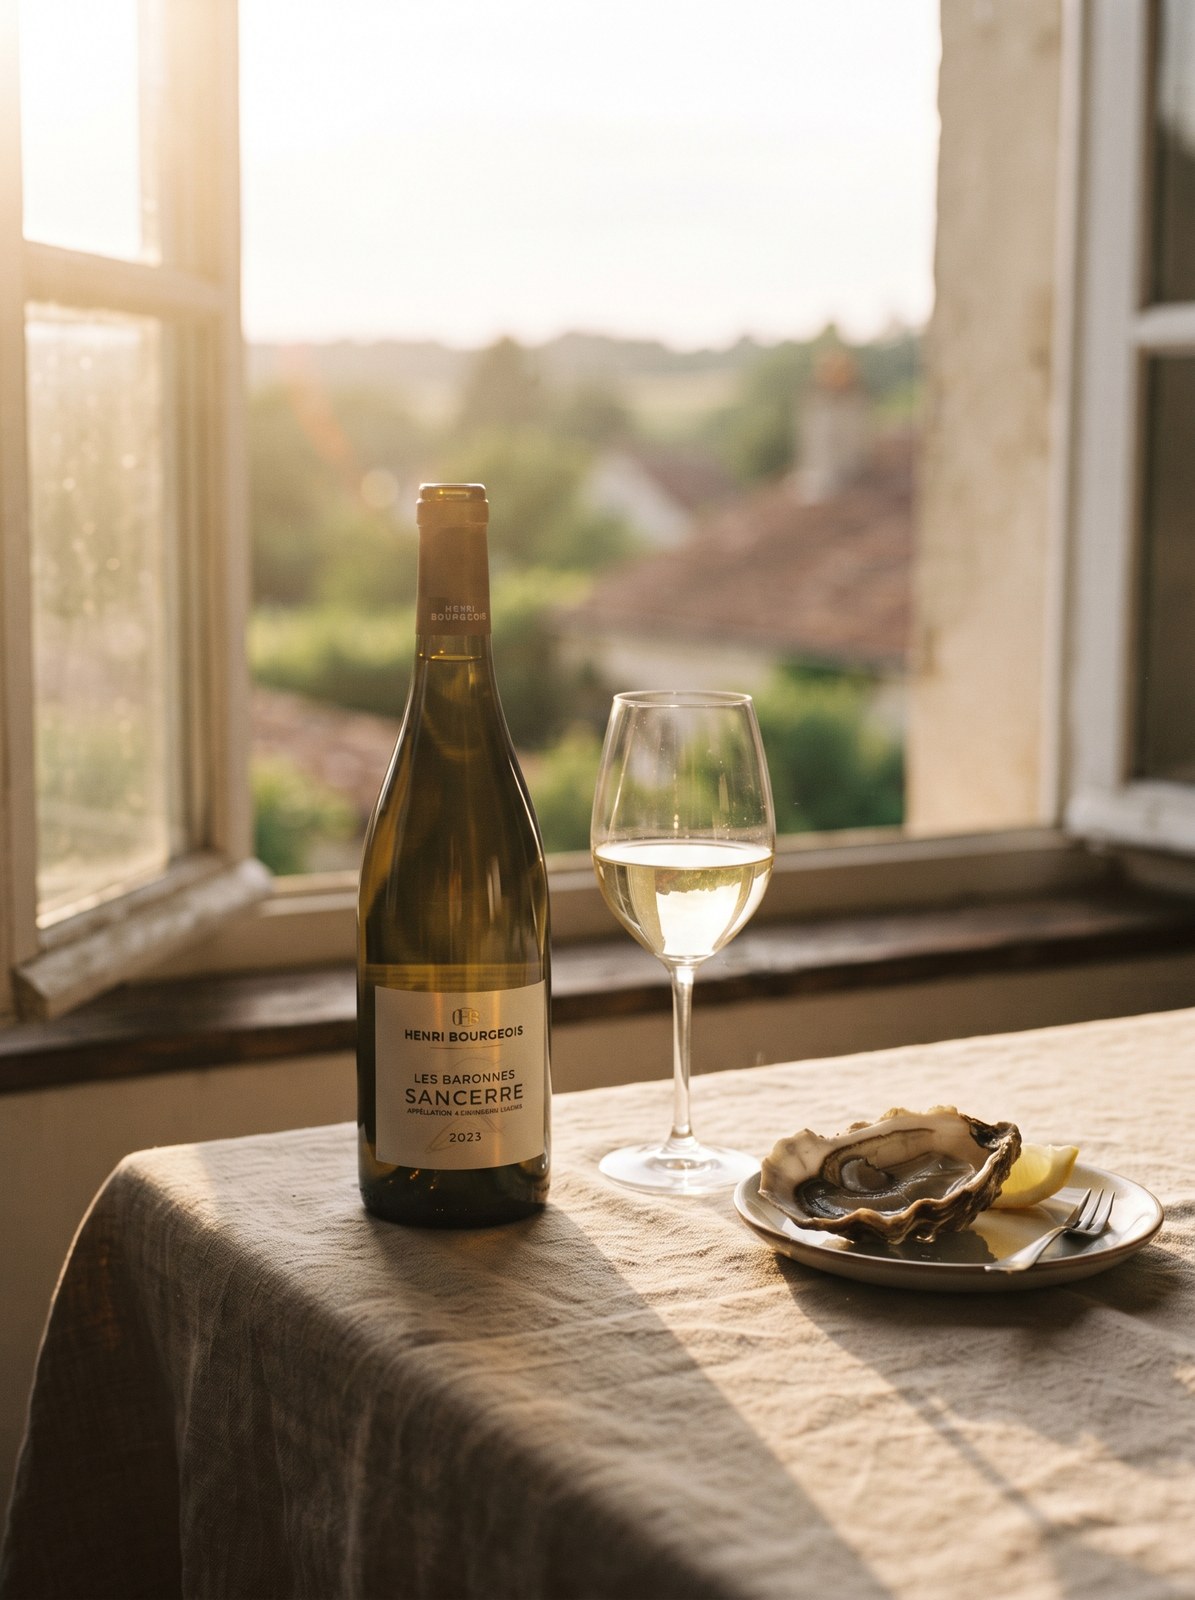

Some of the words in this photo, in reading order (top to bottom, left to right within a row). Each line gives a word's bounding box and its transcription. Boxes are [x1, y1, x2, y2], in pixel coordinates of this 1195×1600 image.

[405, 1029, 444, 1042] HENRI
[449, 1025, 523, 1042] BOURGEOIS
[414, 1073, 438, 1085] LES
[443, 1069, 515, 1085] BARONNES
[405, 1084, 523, 1106] SANCERRE
[449, 1132, 481, 1143] 2023
